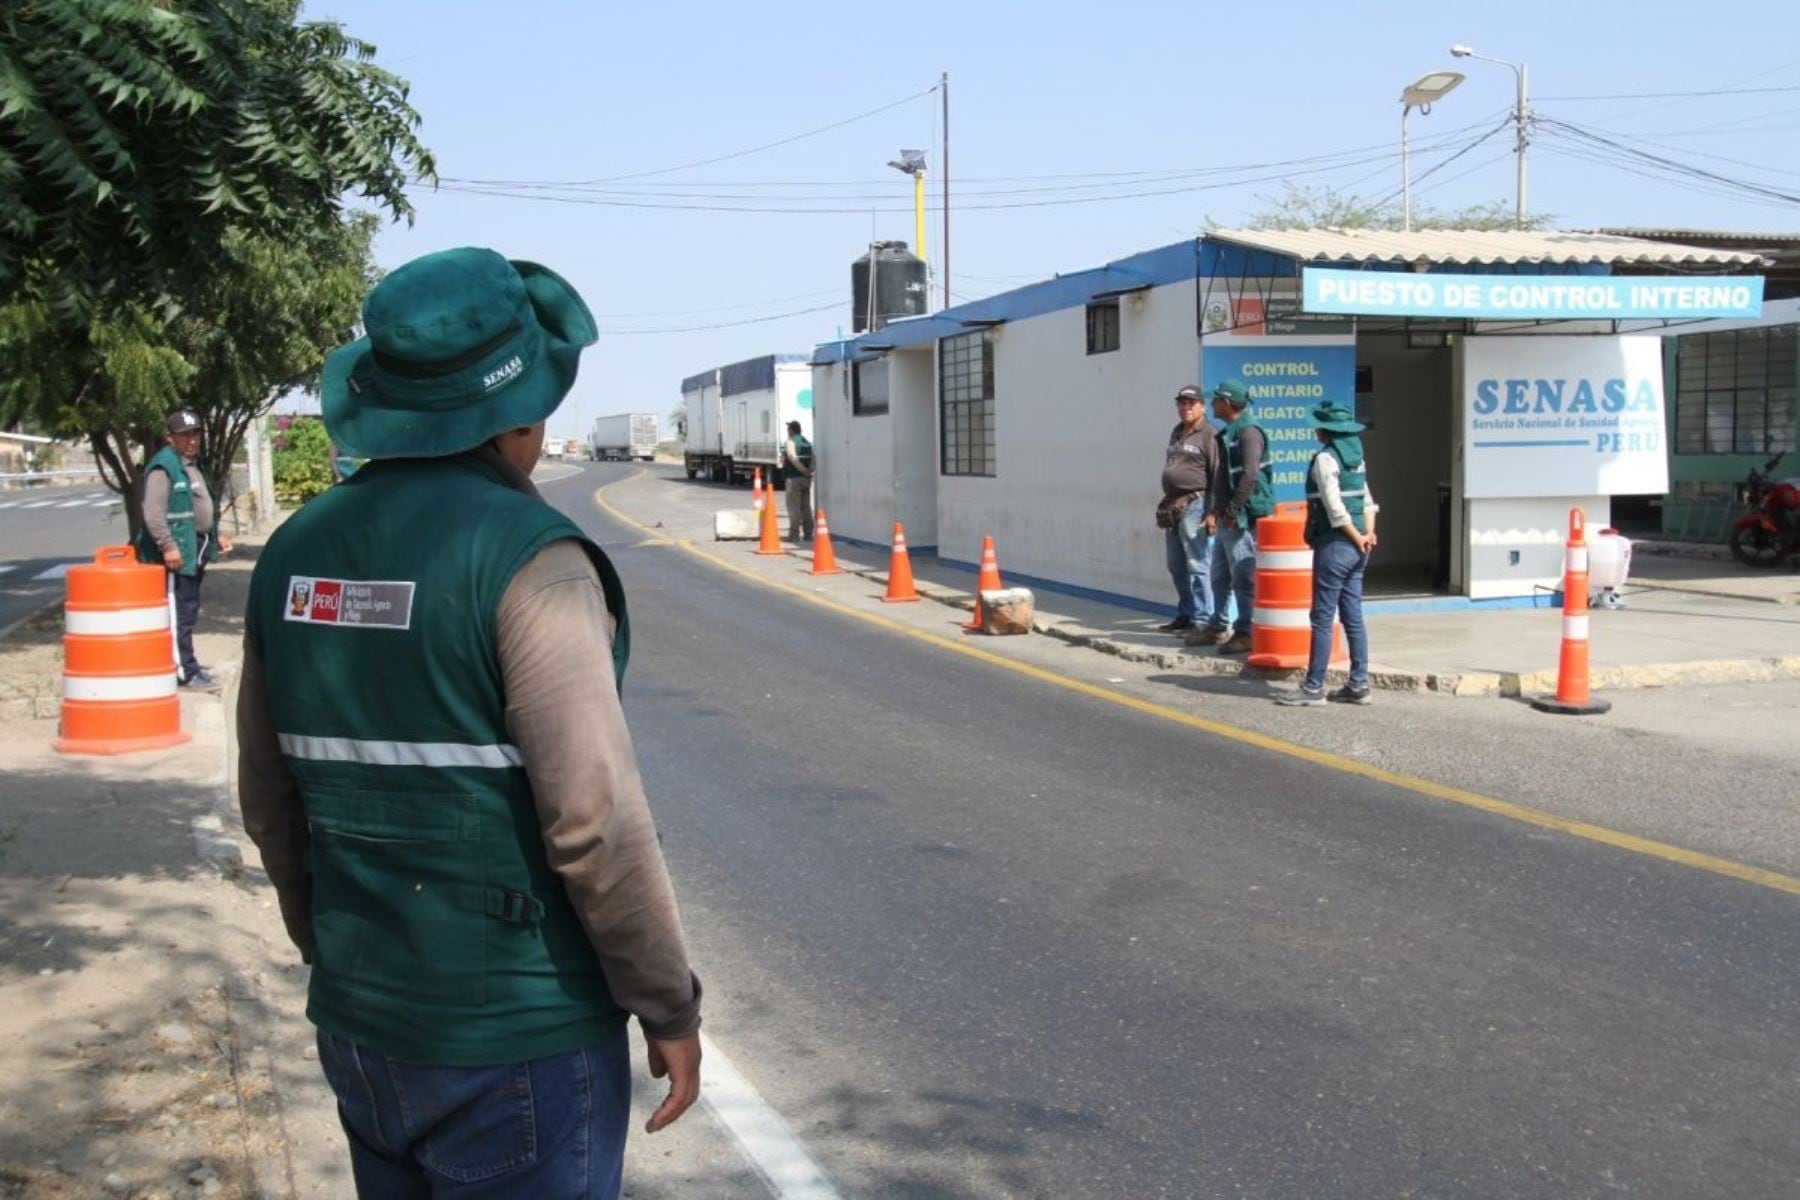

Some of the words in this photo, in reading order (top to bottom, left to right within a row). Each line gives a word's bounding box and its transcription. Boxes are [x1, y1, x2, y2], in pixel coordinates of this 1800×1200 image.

[1318, 278, 1434, 308] PUESTO
[1443, 283, 1482, 308] DE
[1489, 284, 1623, 310] CONTROL
[1630, 284, 1751, 310] INTERNO
[1242, 362, 1319, 376] CONTROL
[1248, 384, 1324, 398] ANITARIO
[1473, 378, 1658, 415] SENASA
[1249, 406, 1306, 420] LIGATO
[1472, 418, 1515, 430] Servicio
[1517, 418, 1562, 429] Nacional
[1564, 417, 1576, 428] de
[1578, 416, 1620, 428] Sanidad
[314, 592, 337, 610] PERÚ
